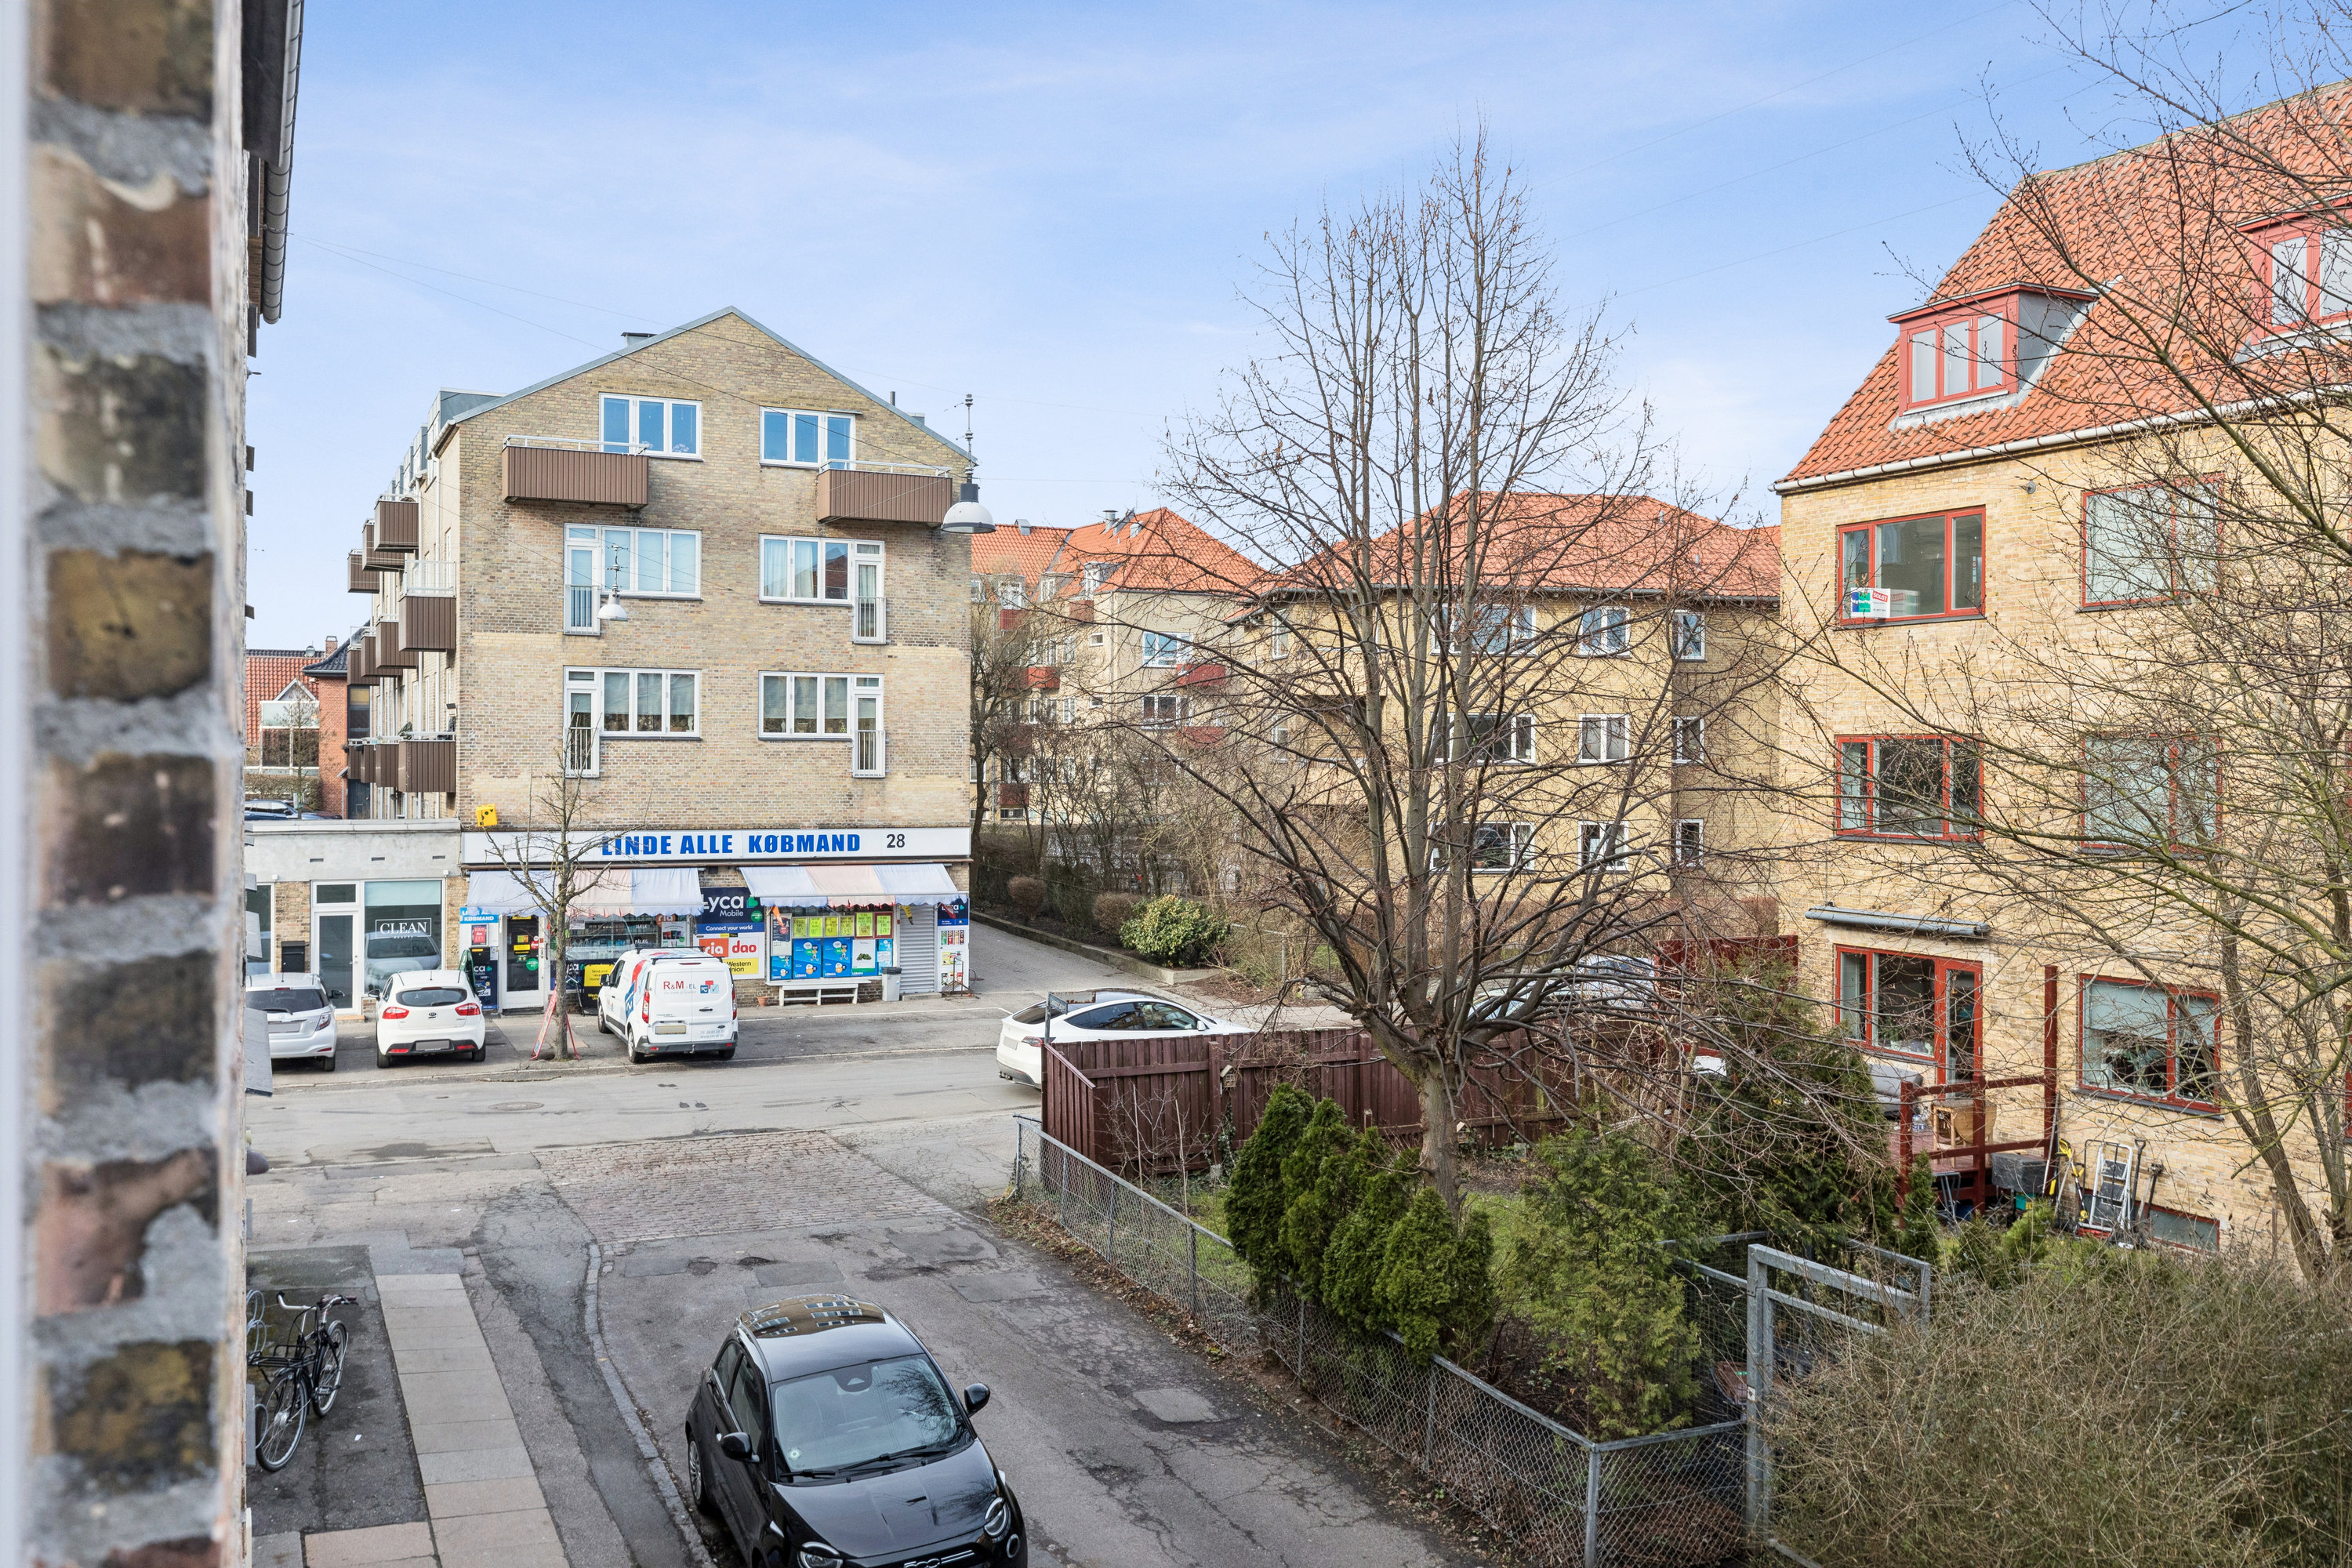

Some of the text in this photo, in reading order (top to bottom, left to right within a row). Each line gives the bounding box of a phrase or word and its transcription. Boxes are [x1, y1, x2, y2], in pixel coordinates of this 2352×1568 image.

[1873, 592, 1888, 601] SOLGT
[601, 833, 906, 855] LINDE ALLE KØBMAND 28
[379, 922, 427, 935] CLEAN
[731, 940, 757, 953] dao
[663, 981, 684, 989] R&M
